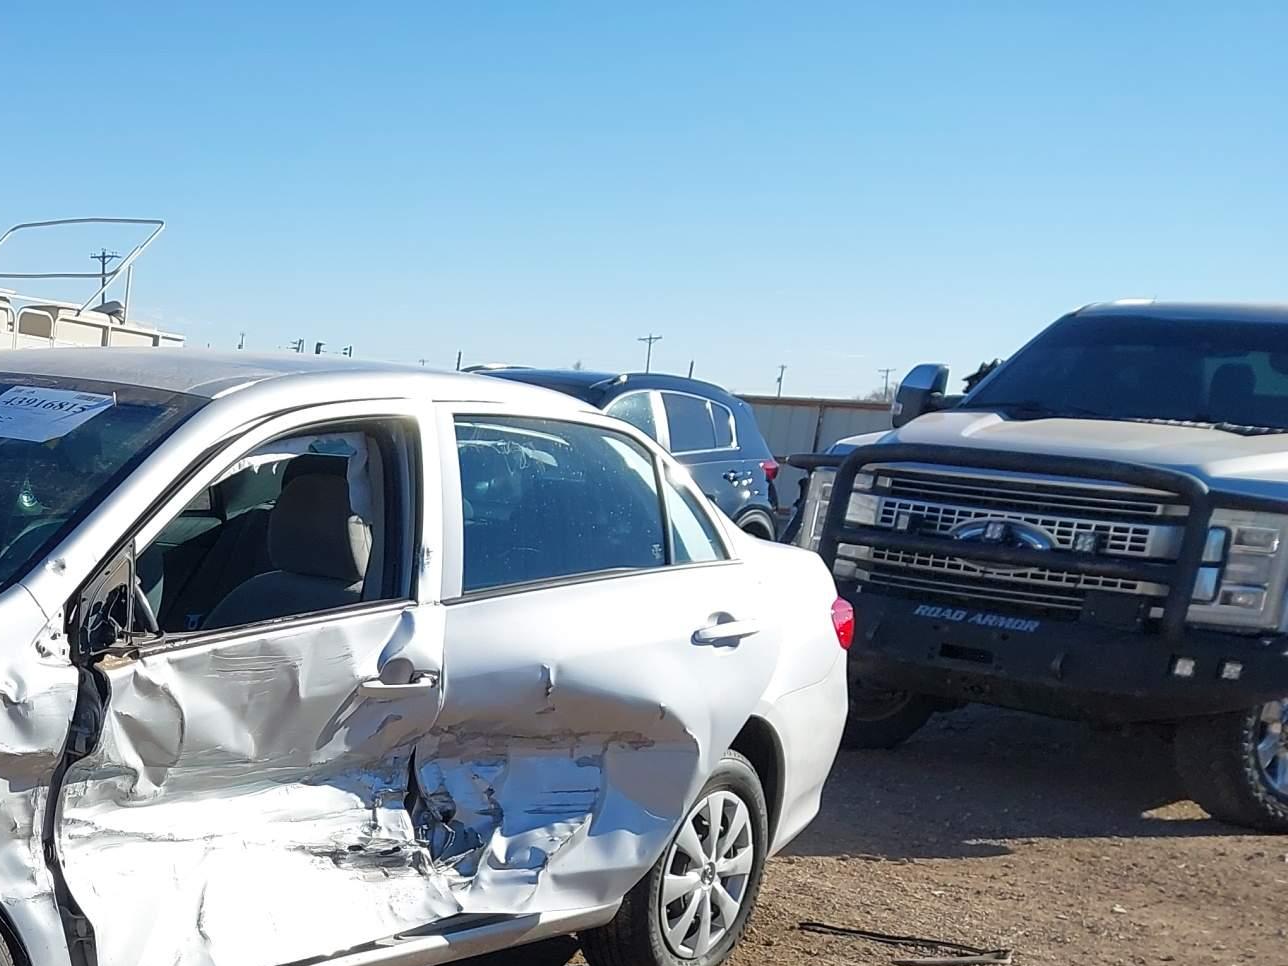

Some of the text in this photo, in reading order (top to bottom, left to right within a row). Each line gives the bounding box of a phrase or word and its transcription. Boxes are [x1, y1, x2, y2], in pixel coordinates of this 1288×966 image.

[2, 395, 89, 414] 43916815
[913, 604, 1041, 633] ROAD ARMOR
